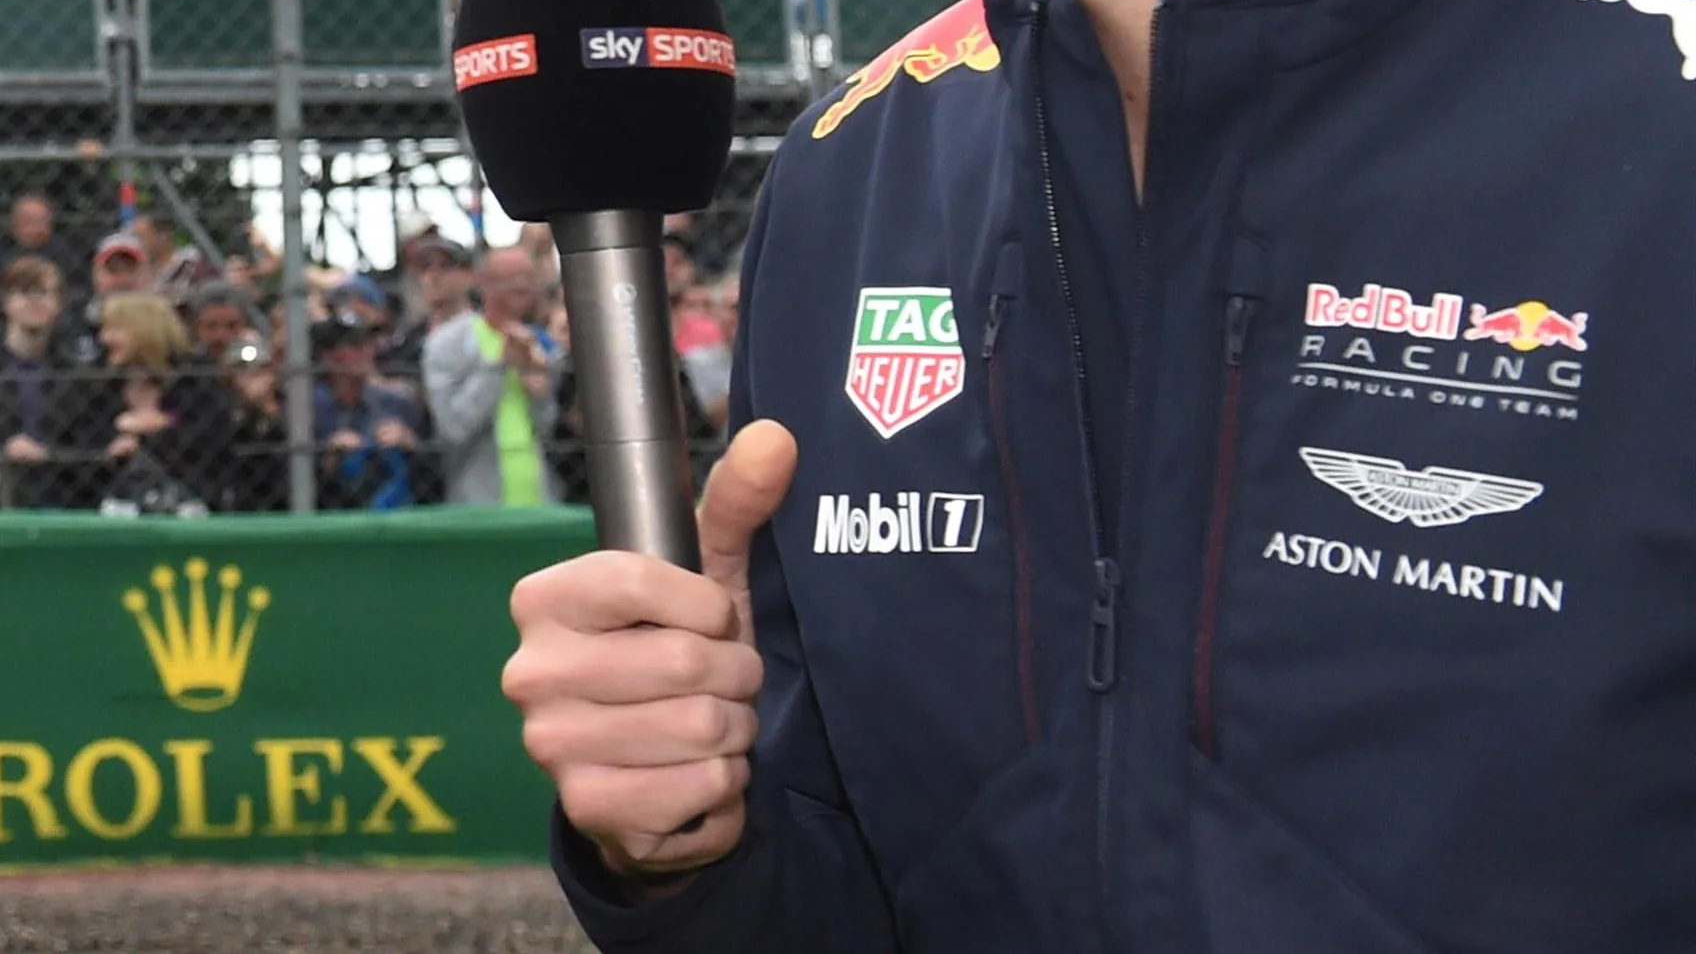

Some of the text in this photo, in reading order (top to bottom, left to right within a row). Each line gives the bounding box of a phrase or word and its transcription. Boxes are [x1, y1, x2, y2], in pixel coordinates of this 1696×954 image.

[589, 30, 643, 65] sky
[866, 299, 959, 343] TAG
[1299, 334, 1583, 388] RACING
[854, 357, 959, 424] HEUER
[1290, 374, 1579, 421] FORMULA ONE TEAM
[813, 492, 922, 554] Mobil
[1263, 531, 1564, 613] ASTON MARTIN
